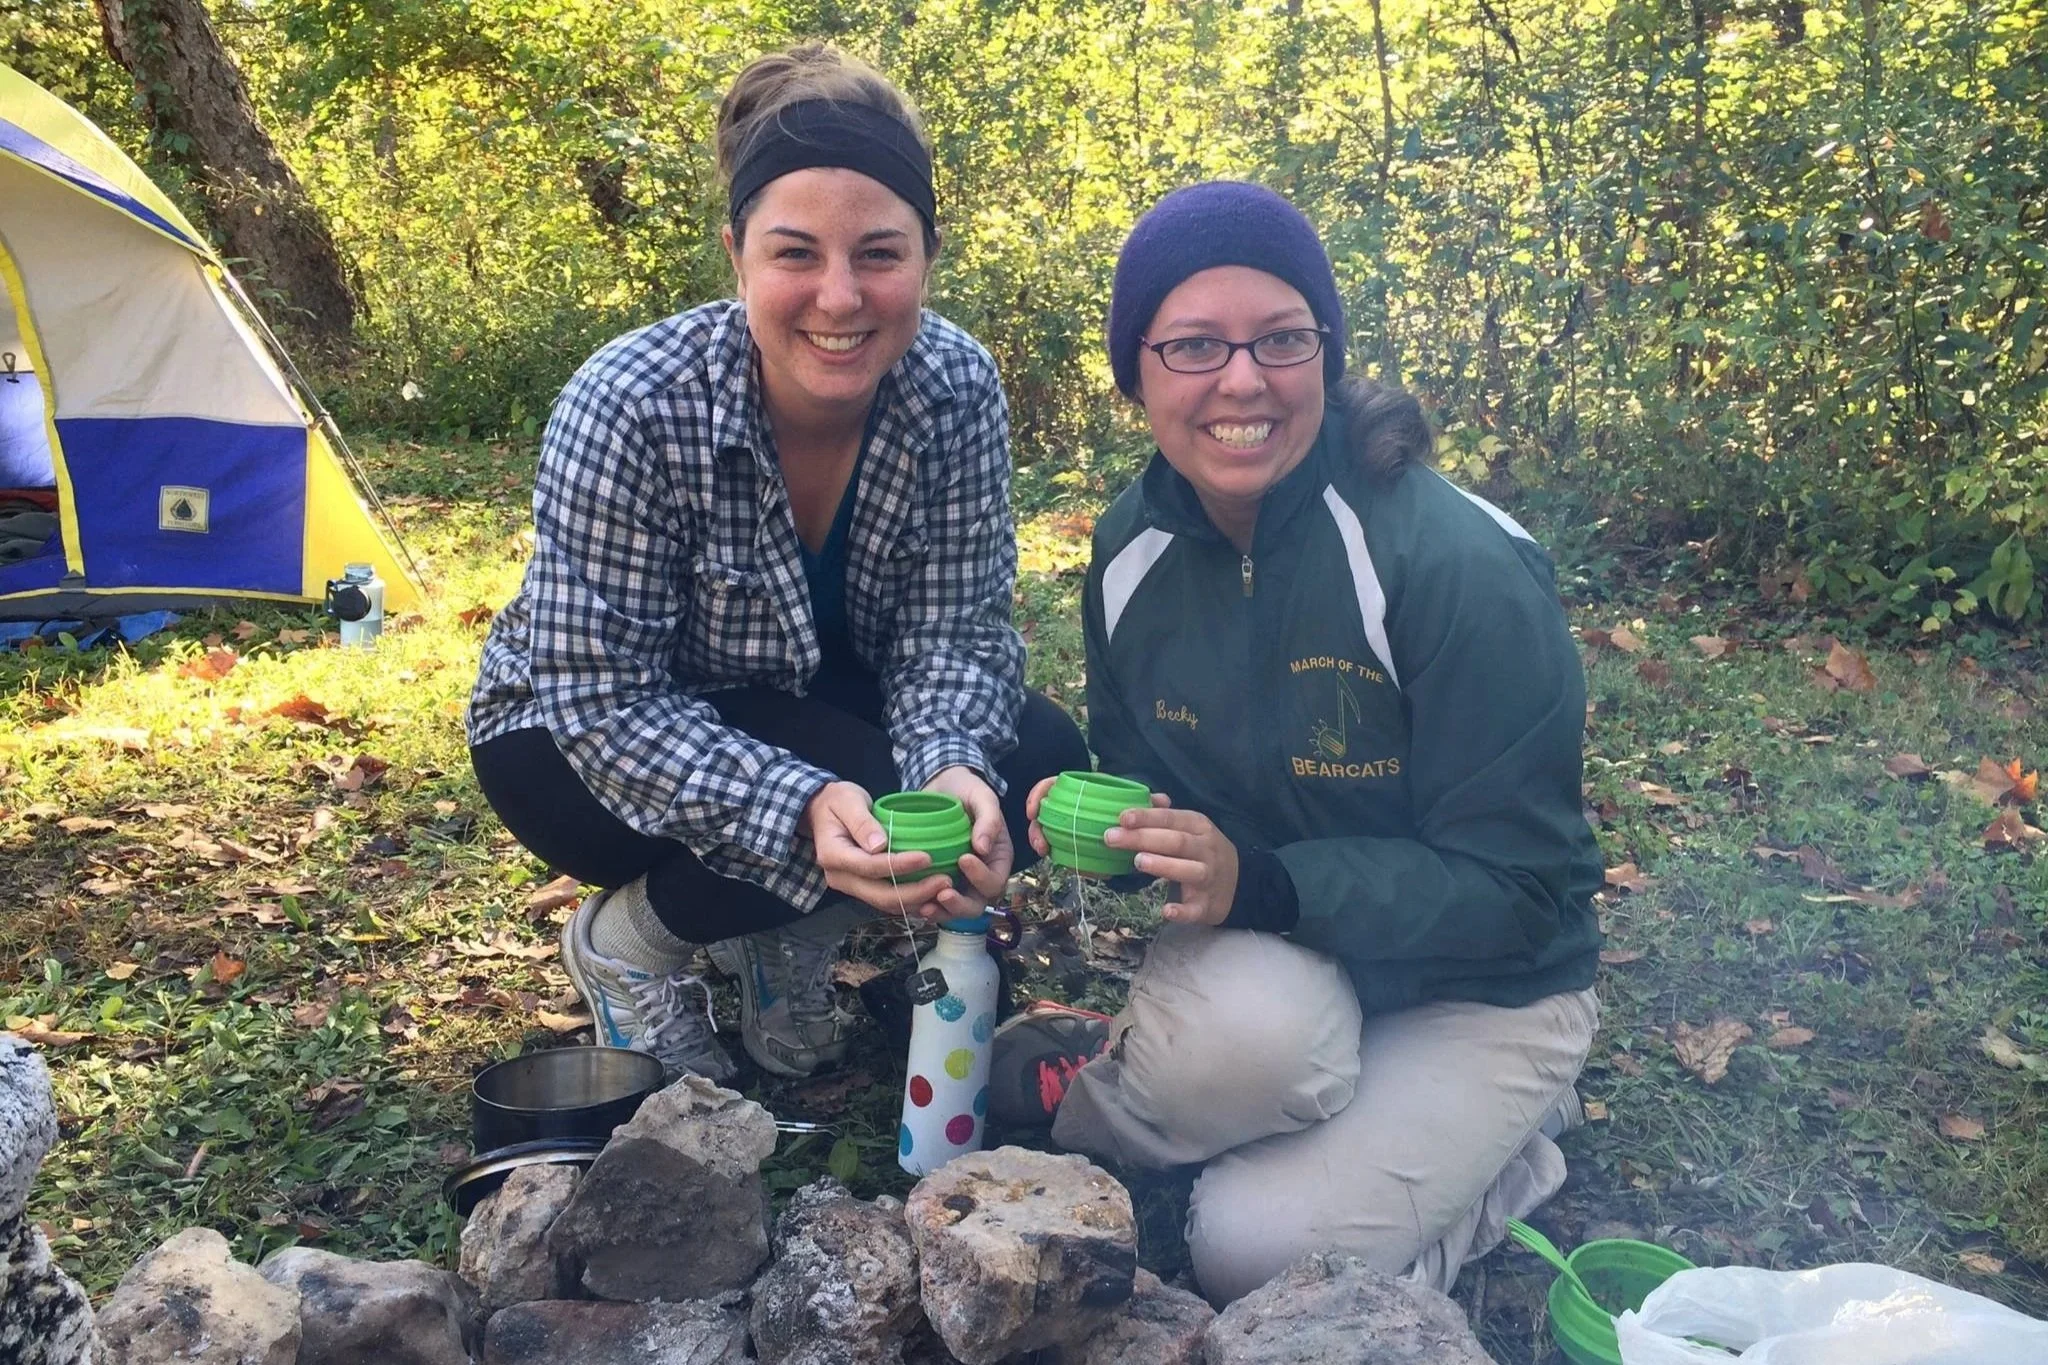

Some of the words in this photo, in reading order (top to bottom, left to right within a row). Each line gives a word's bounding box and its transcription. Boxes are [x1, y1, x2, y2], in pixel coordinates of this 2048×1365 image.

[1290, 656, 1335, 673] MARCH
[1338, 659, 1353, 673] OF
[1357, 664, 1384, 684] THE
[1155, 699, 1199, 730] Becky
[1291, 756, 1400, 778] BEARCATS
